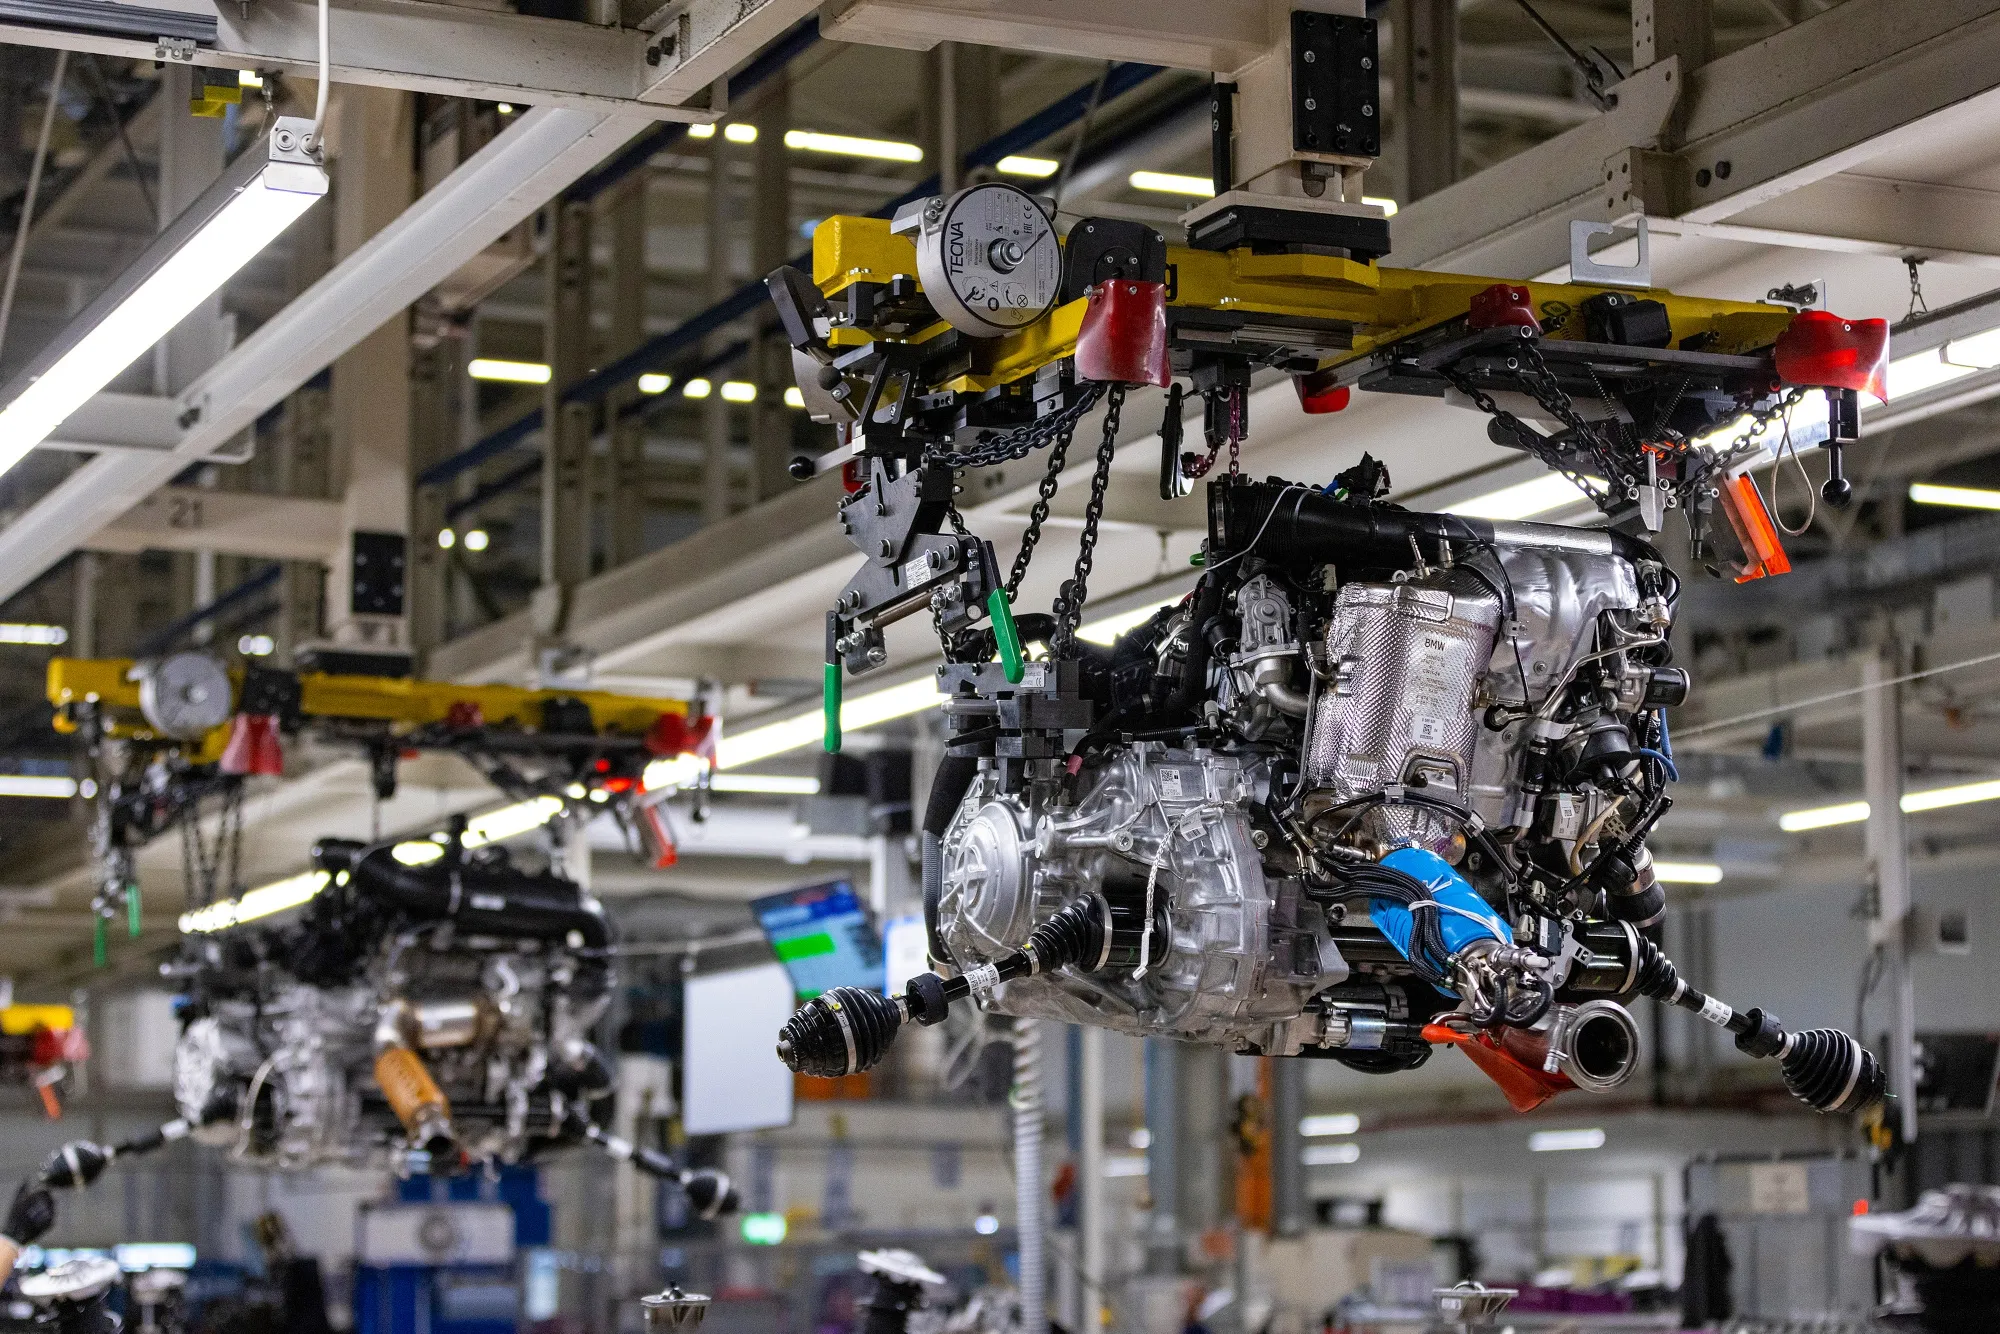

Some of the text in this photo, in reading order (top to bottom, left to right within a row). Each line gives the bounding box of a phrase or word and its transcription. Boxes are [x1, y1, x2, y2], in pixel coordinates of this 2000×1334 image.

[950, 221, 964, 276] TECNA
[170, 496, 203, 528] 21
[1425, 638, 1445, 651] BMW
